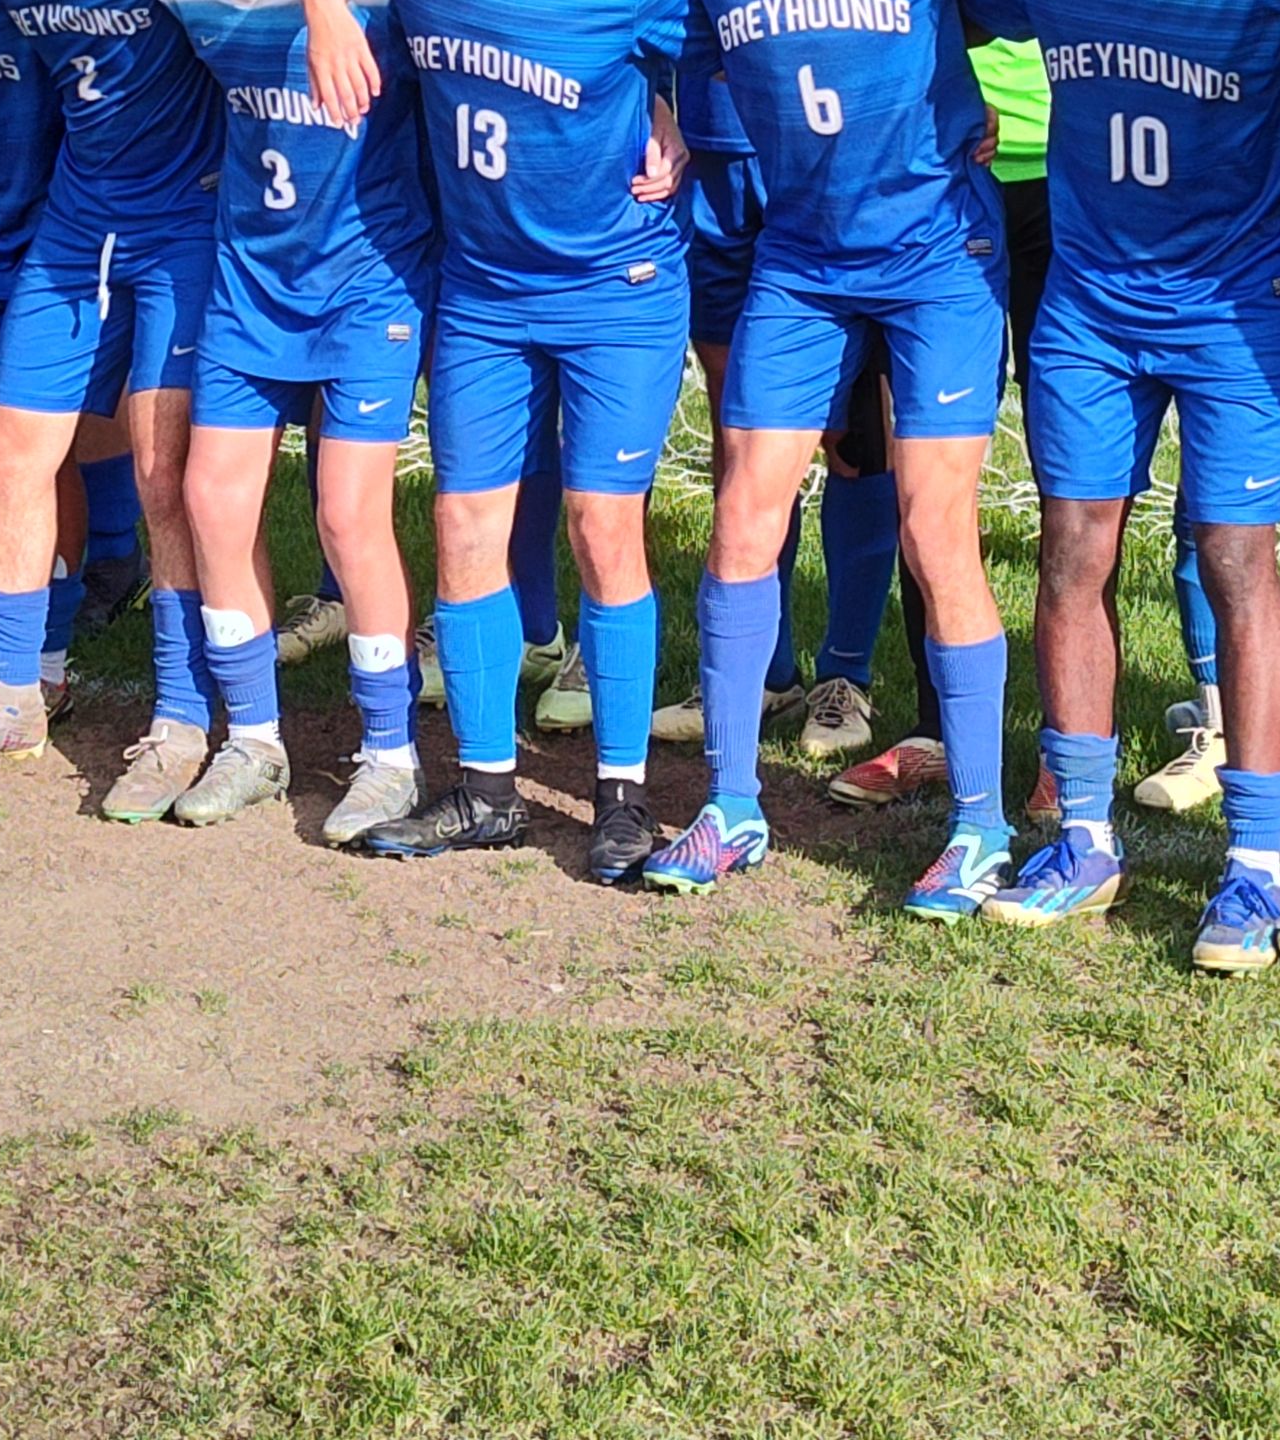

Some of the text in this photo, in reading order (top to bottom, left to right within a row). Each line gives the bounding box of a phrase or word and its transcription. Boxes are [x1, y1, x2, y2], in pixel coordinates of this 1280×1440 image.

[71, 55, 108, 101] 2
[797, 64, 844, 136] 6
[1045, 42, 1240, 102] GREYHOUNDS
[456, 103, 508, 181] 13
[1110, 112, 1169, 187] 10
[261, 148, 298, 210] 3
